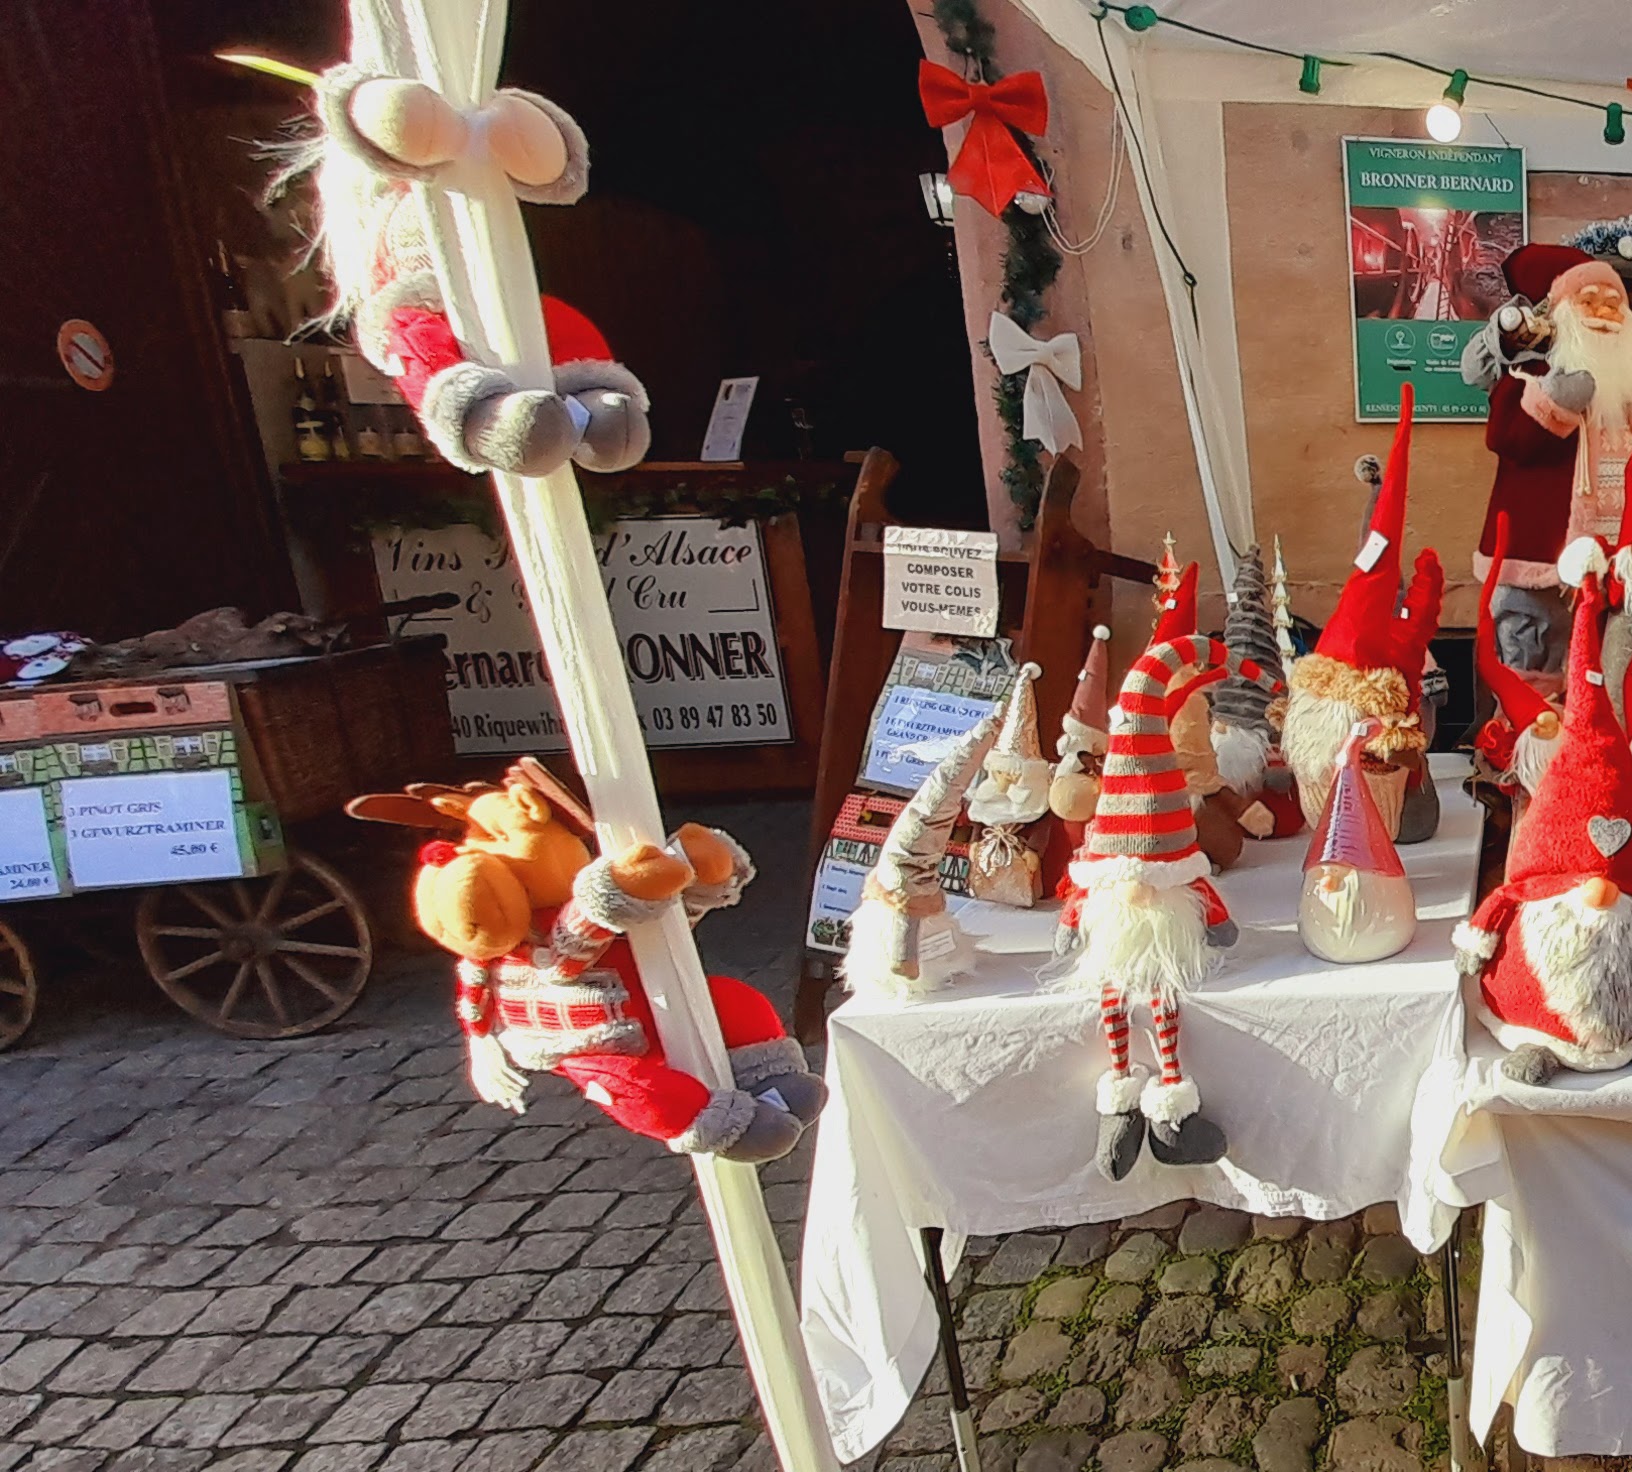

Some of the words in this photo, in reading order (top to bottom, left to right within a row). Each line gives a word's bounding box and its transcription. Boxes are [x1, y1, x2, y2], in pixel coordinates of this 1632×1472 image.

[1369, 147, 1426, 160] VIGNERON
[1361, 172, 1437, 190] BRONNER
[1440, 176, 1514, 193] BERNARD
[388, 538, 462, 571] Vins
[907, 563, 974, 579] COMPOSER
[627, 575, 687, 610] Cru
[901, 582, 942, 596] VOTRE
[944, 584, 982, 599] COLIS
[627, 631, 775, 684] ONNER
[653, 707, 674, 731] 03
[679, 706, 700, 730] 89
[707, 705, 724, 728] 47
[731, 704, 751, 727] 83
[756, 703, 777, 726] 50
[80, 803, 122, 816] PINOT
[127, 801, 163, 814] GRIS
